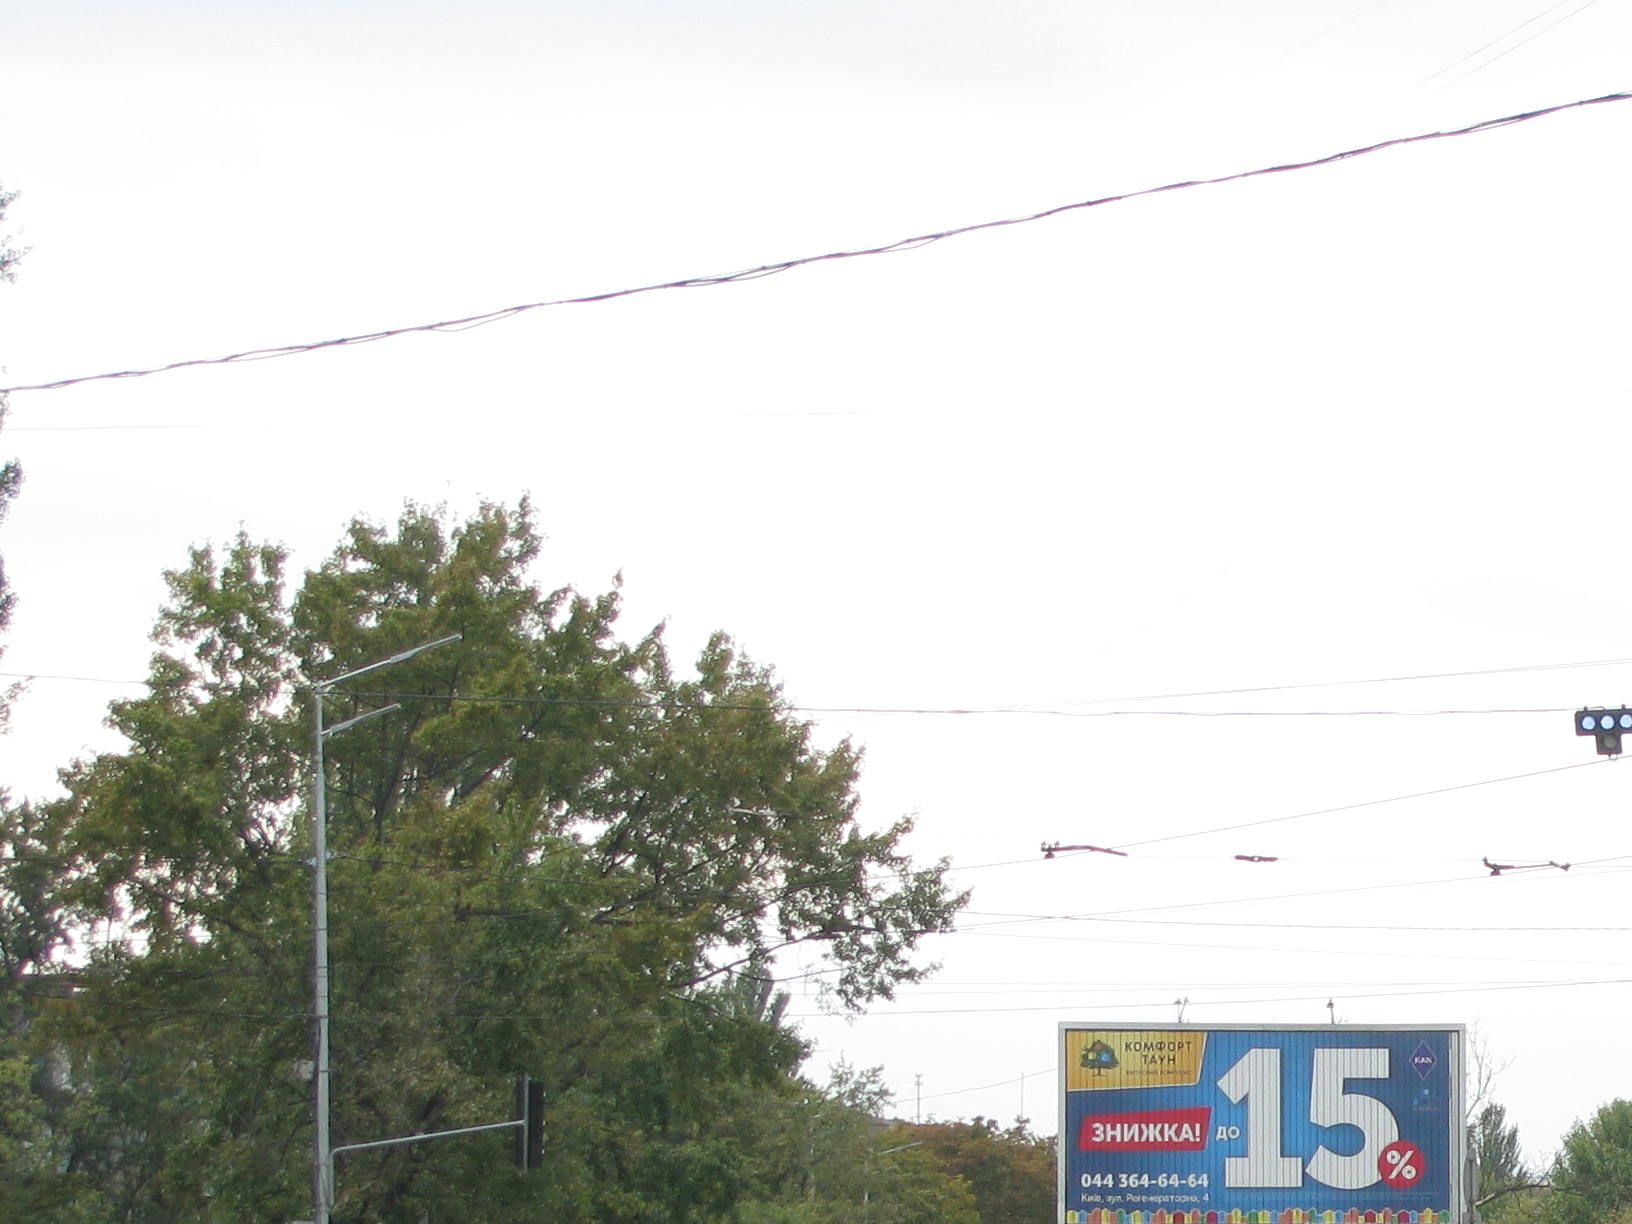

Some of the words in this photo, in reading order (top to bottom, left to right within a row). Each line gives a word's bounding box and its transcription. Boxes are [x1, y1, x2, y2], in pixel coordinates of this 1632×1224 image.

[1124, 1041, 1193, 1052] КОМФОРТ
[1141, 1054, 1176, 1065] ТАУН
[1091, 1122, 1201, 1143] ЗНИЖКА!
[1081, 1173, 1114, 1188] 044
[1118, 1173, 1209, 1188] 364-64-64
